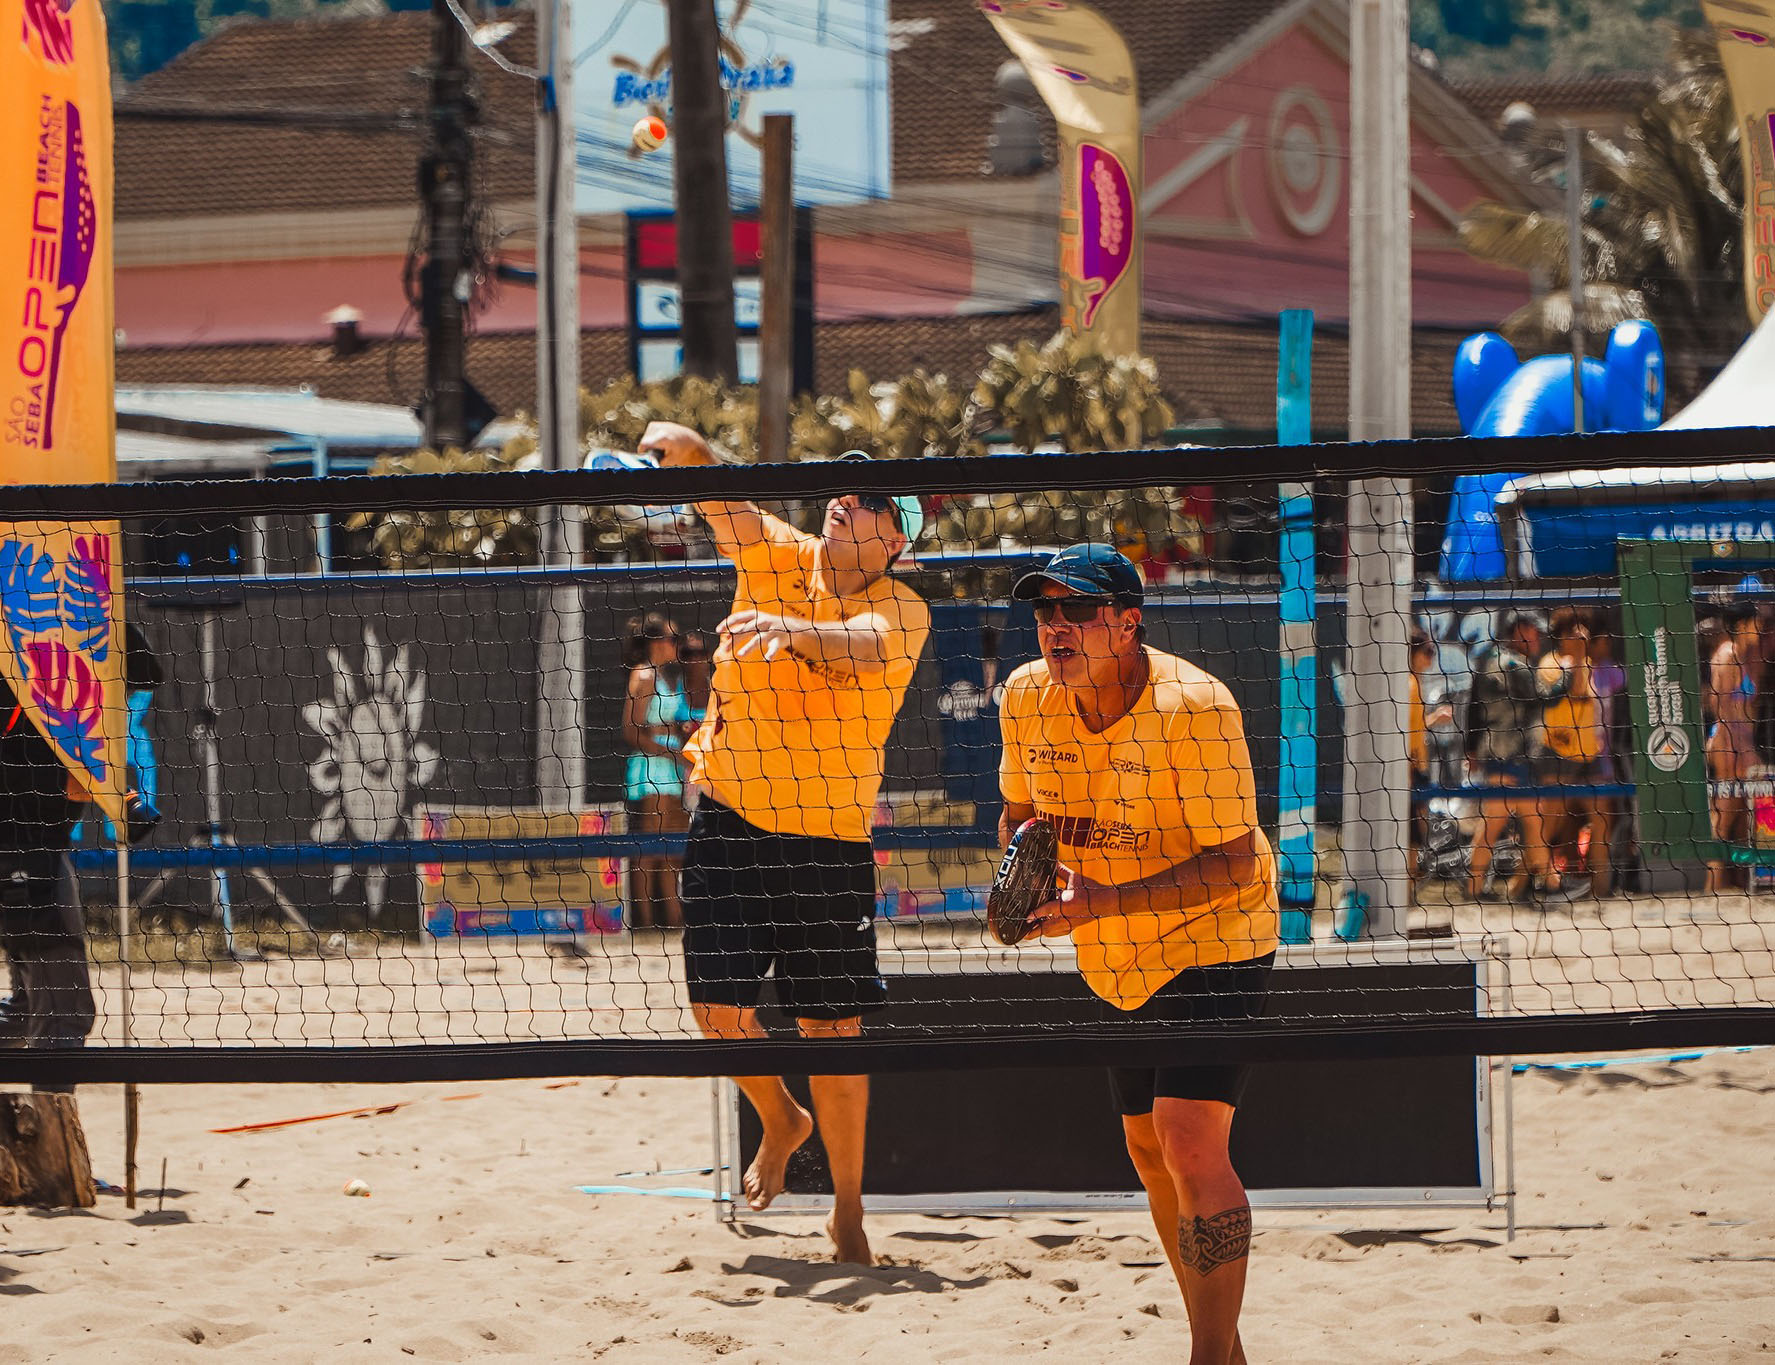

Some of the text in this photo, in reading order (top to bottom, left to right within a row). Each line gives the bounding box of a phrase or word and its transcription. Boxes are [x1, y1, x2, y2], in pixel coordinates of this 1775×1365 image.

[36, 94, 52, 183] BEACH
[18, 190, 59, 378] OPEN
[1039, 750, 1079, 763] WIZARD
[1092, 828, 1150, 845] OPEN
